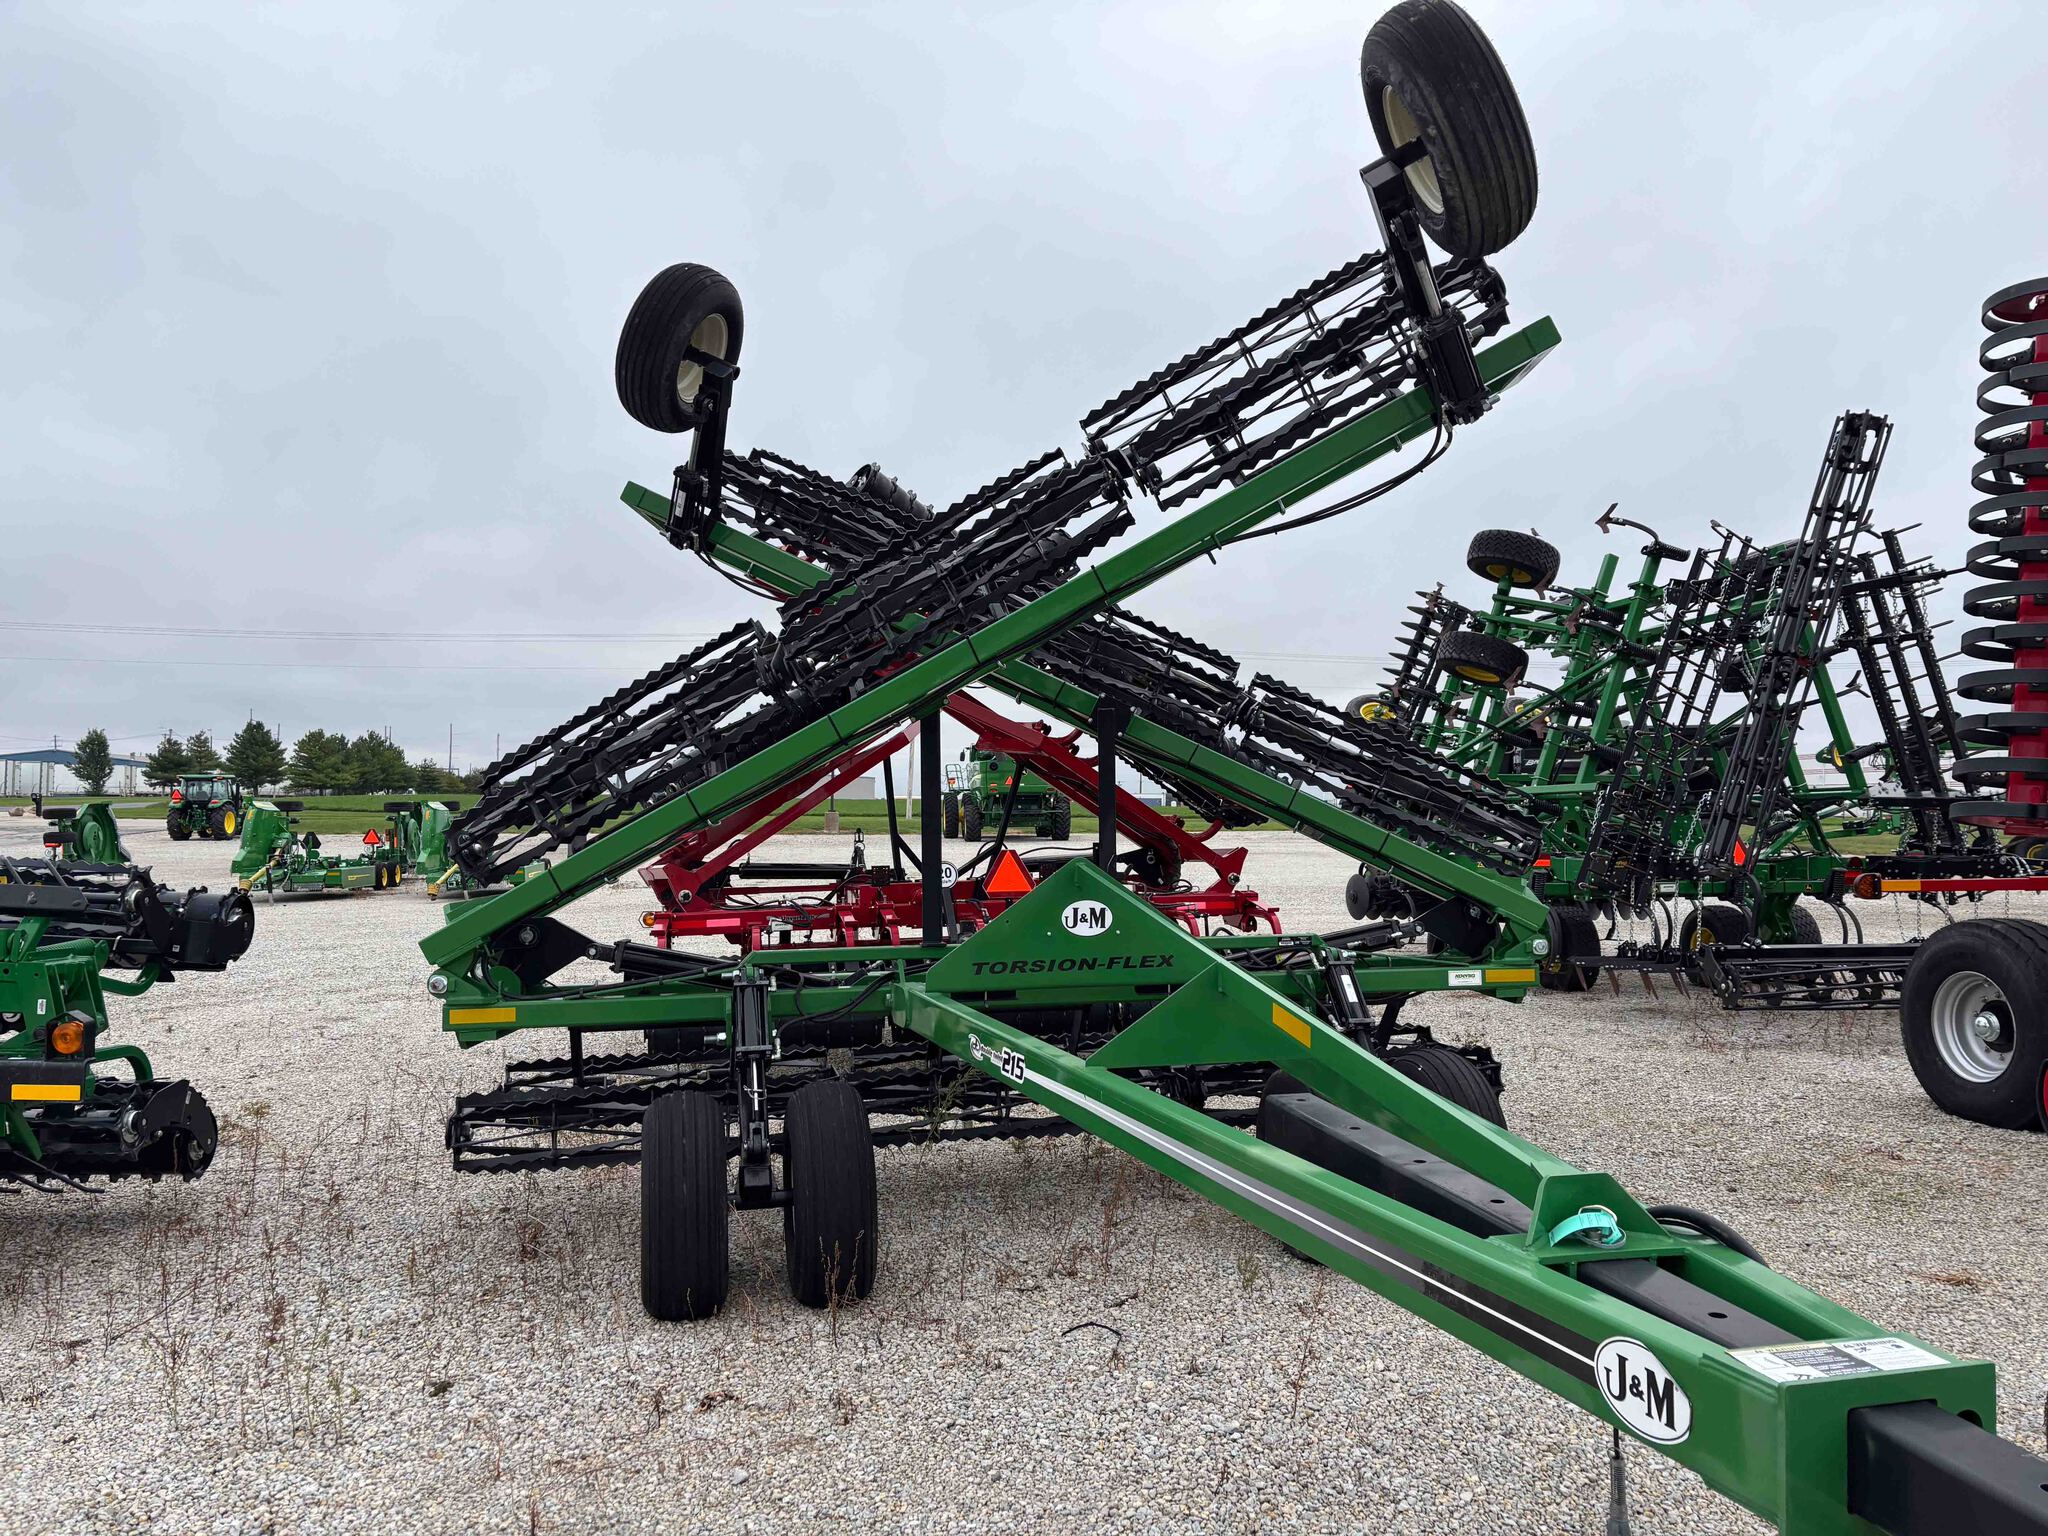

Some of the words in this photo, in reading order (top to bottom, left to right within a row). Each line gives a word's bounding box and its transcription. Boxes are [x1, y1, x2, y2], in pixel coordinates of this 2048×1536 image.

[1064, 907, 1107, 929] J&M
[972, 954, 1175, 976] TORSION-FLEX
[1002, 1050, 1025, 1081] 215
[1604, 1352, 1677, 1432] J&M
